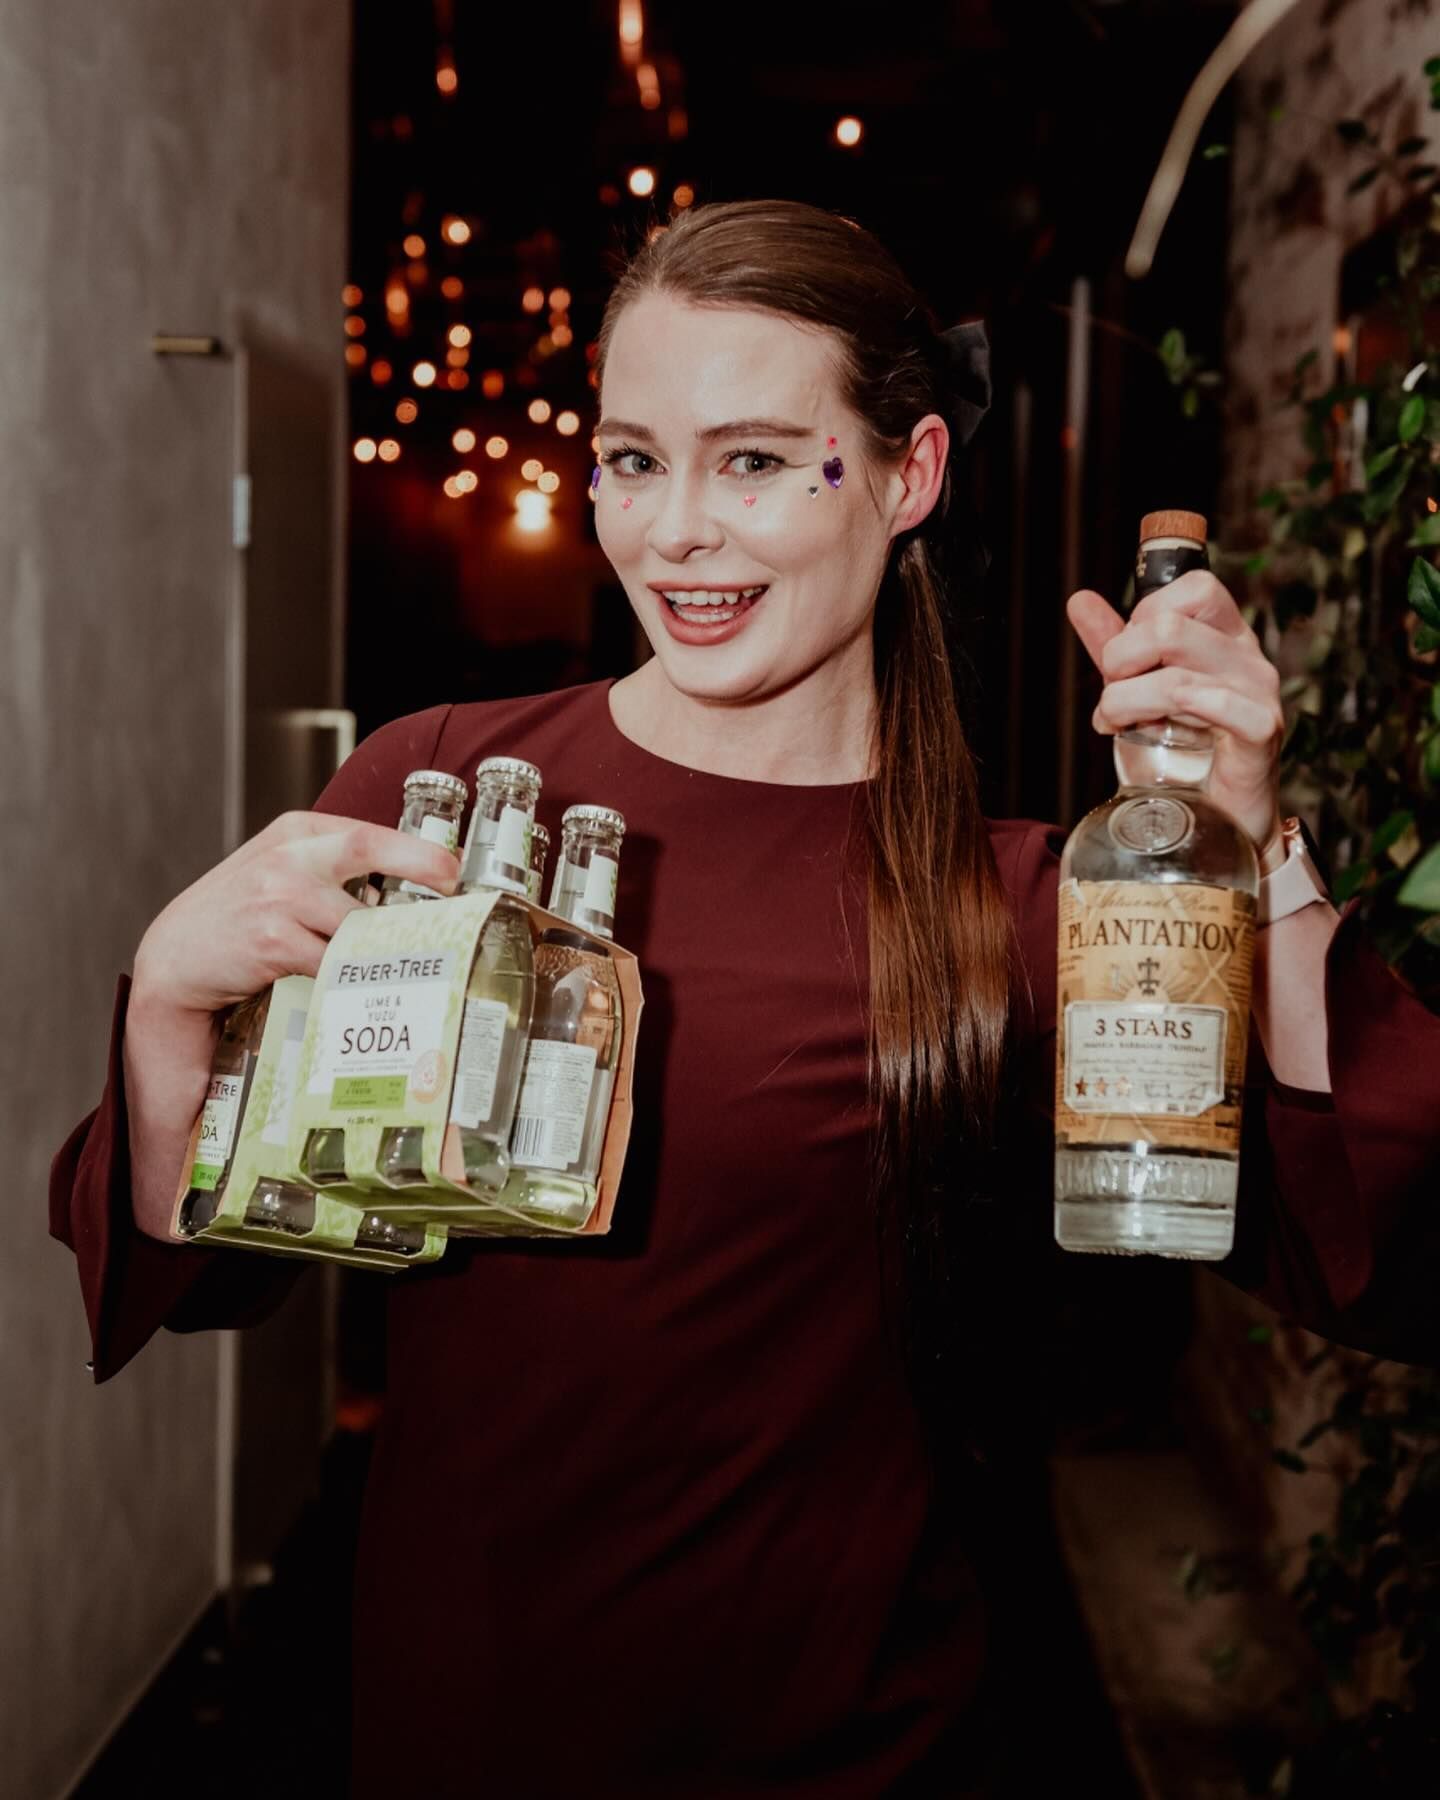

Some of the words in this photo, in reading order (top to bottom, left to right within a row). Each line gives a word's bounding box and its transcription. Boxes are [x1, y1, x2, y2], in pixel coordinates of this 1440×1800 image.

[1068, 917, 1239, 953] PLANTATION
[338, 958, 443, 984] FEVER-TREE
[365, 996, 391, 1009] LIME
[368, 1010, 396, 1022] YUZU
[341, 1024, 411, 1055] SODA
[1094, 1018, 1106, 1036] 3
[1114, 1018, 1193, 1039] STARS
